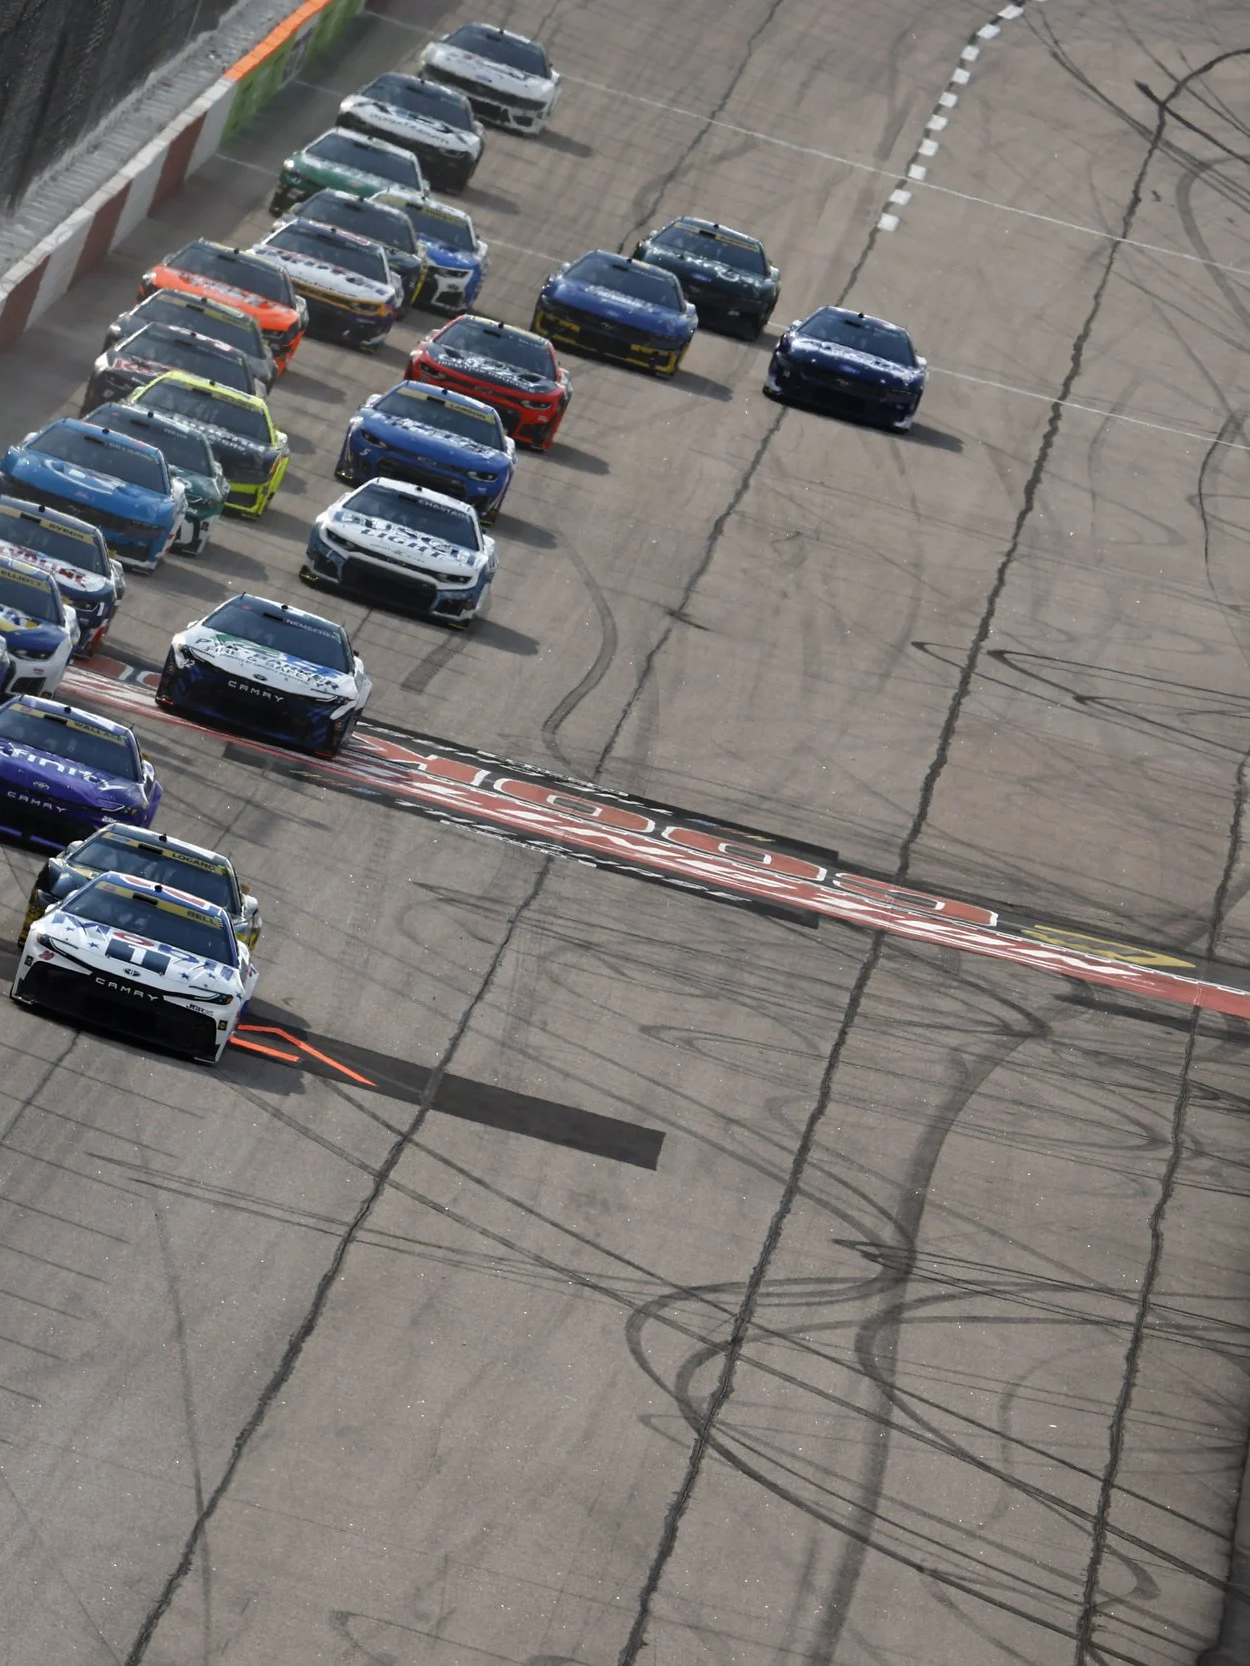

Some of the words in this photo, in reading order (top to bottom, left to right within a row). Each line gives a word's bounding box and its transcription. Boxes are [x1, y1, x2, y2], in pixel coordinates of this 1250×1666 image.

[360, 528, 447, 559] LIGHT
[228, 679, 286, 703] CAMRY
[6, 790, 68, 814] CAMRY
[171, 852, 217, 872] LOGANO
[94, 976, 160, 1001] CAMRY
